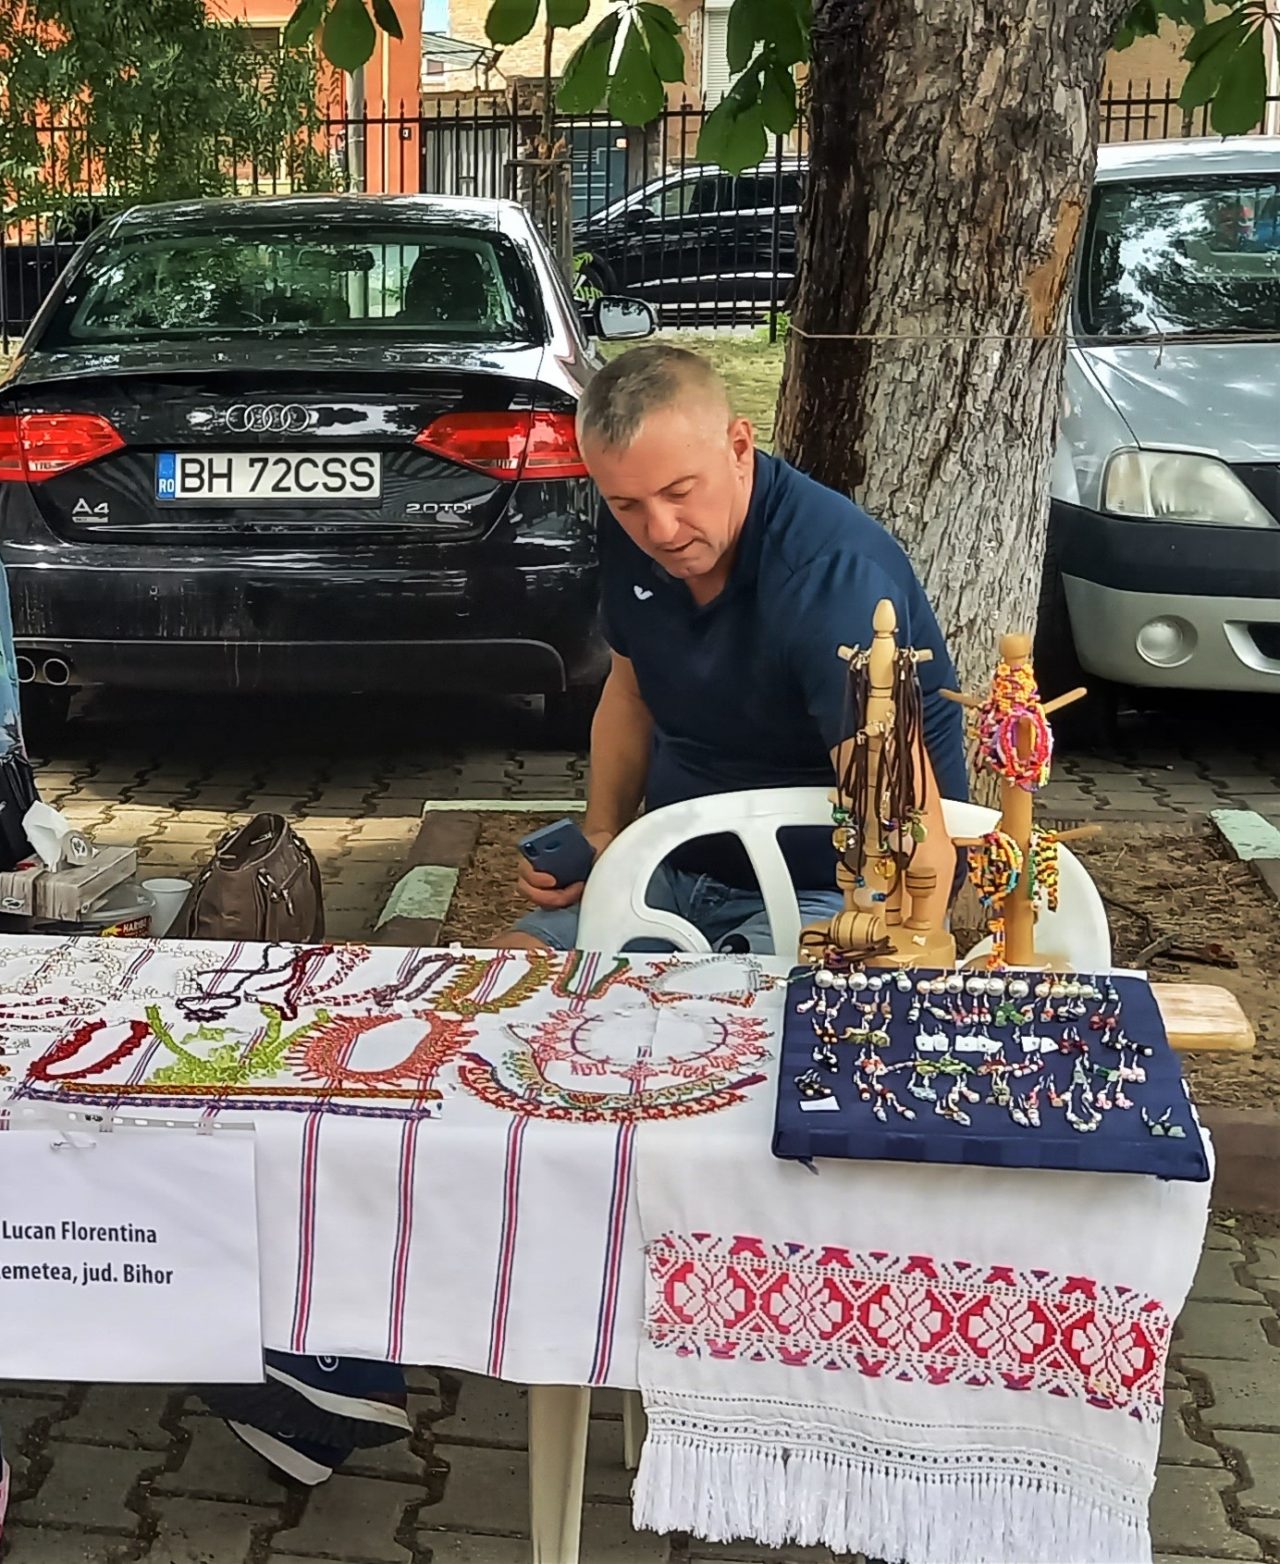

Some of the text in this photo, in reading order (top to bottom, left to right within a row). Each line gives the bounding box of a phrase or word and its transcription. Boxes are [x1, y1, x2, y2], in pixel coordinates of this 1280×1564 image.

[158, 478, 175, 493] RO
[180, 456, 376, 493] BH 72CSS
[72, 497, 110, 515] A4
[2, 1220, 157, 1243] Lucan Florentina
[81, 1262, 118, 1286] jud.
[123, 1264, 173, 1285] Bihor
